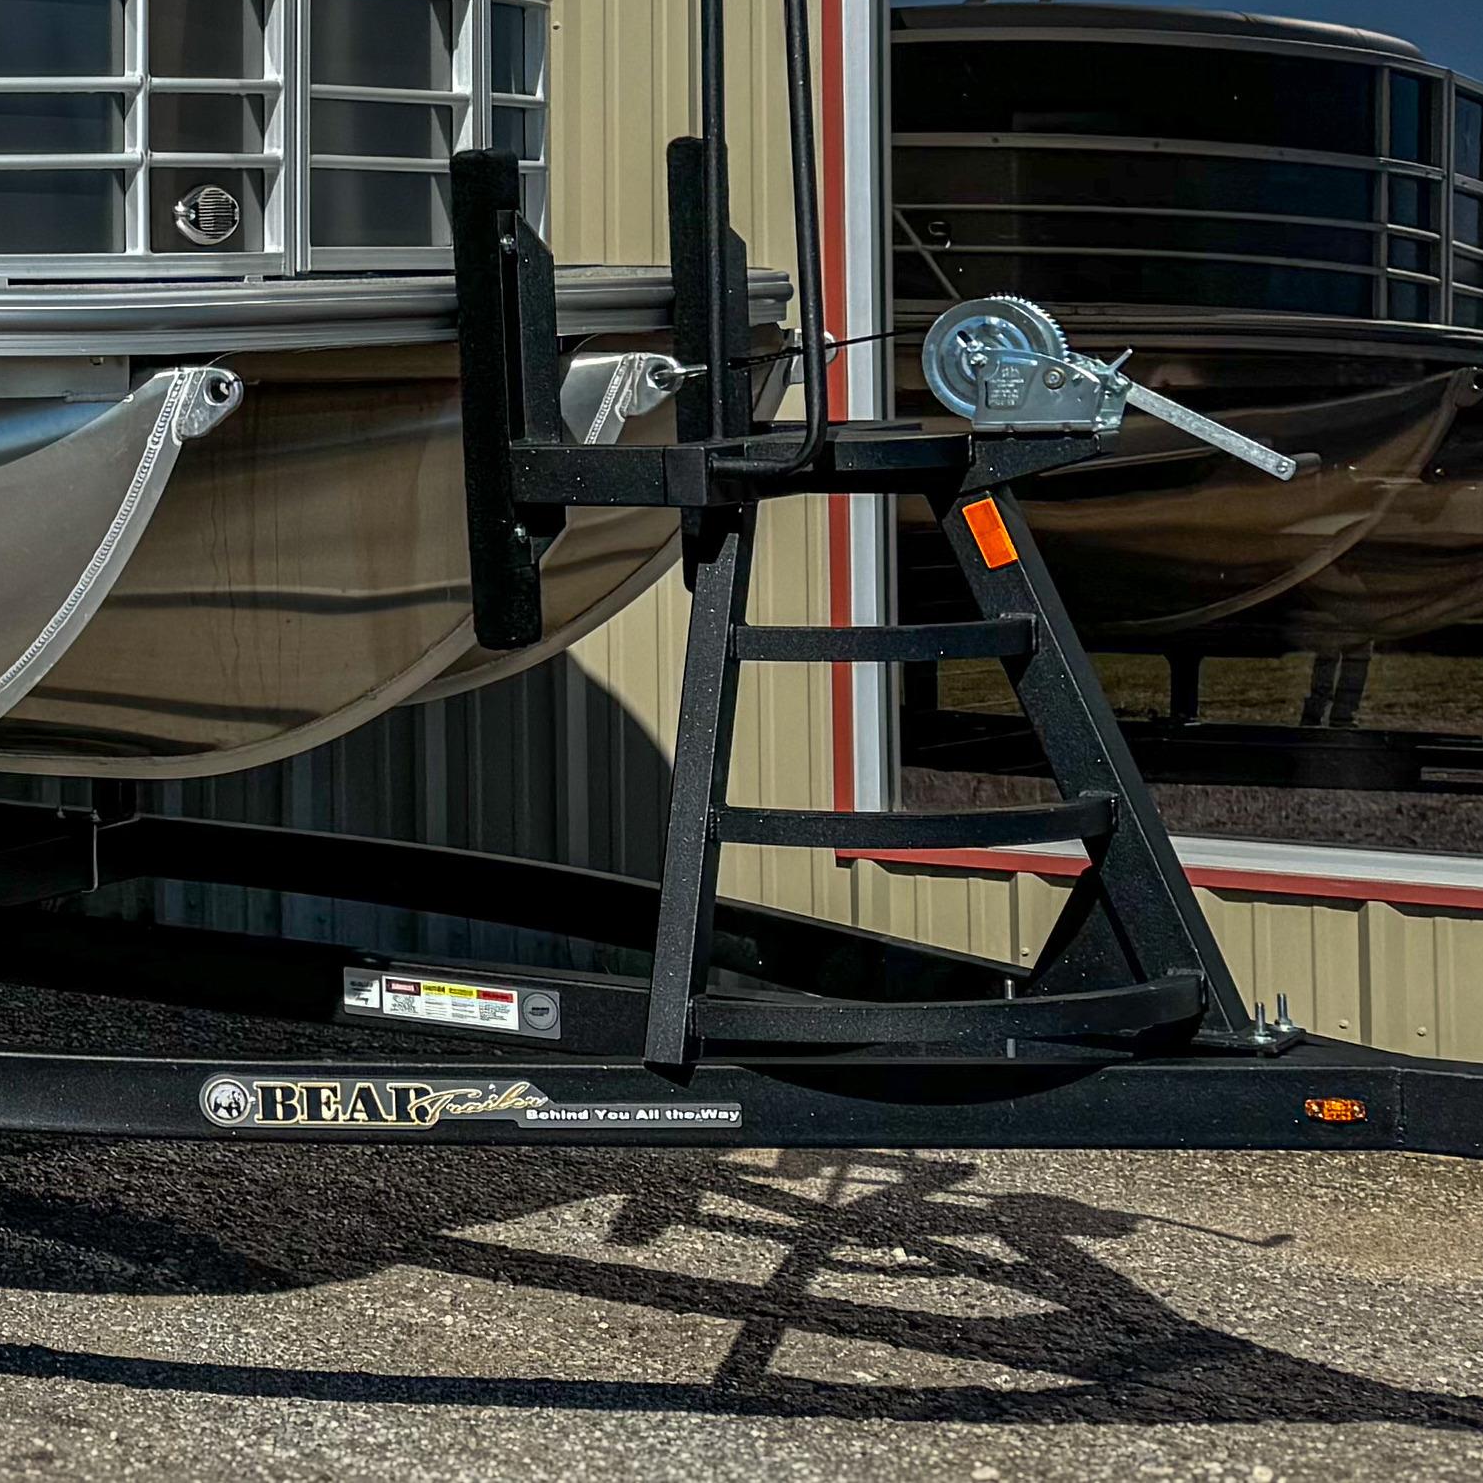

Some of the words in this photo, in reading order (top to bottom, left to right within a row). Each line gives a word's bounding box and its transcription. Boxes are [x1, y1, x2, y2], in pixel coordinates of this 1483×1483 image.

[253, 1081, 436, 1125] BEAR
[525, 1109, 590, 1121] Behind
[594, 1109, 630, 1121] You
[635, 1109, 660, 1121] All
[665, 1109, 695, 1121] the
[700, 1109, 740, 1122] Way
